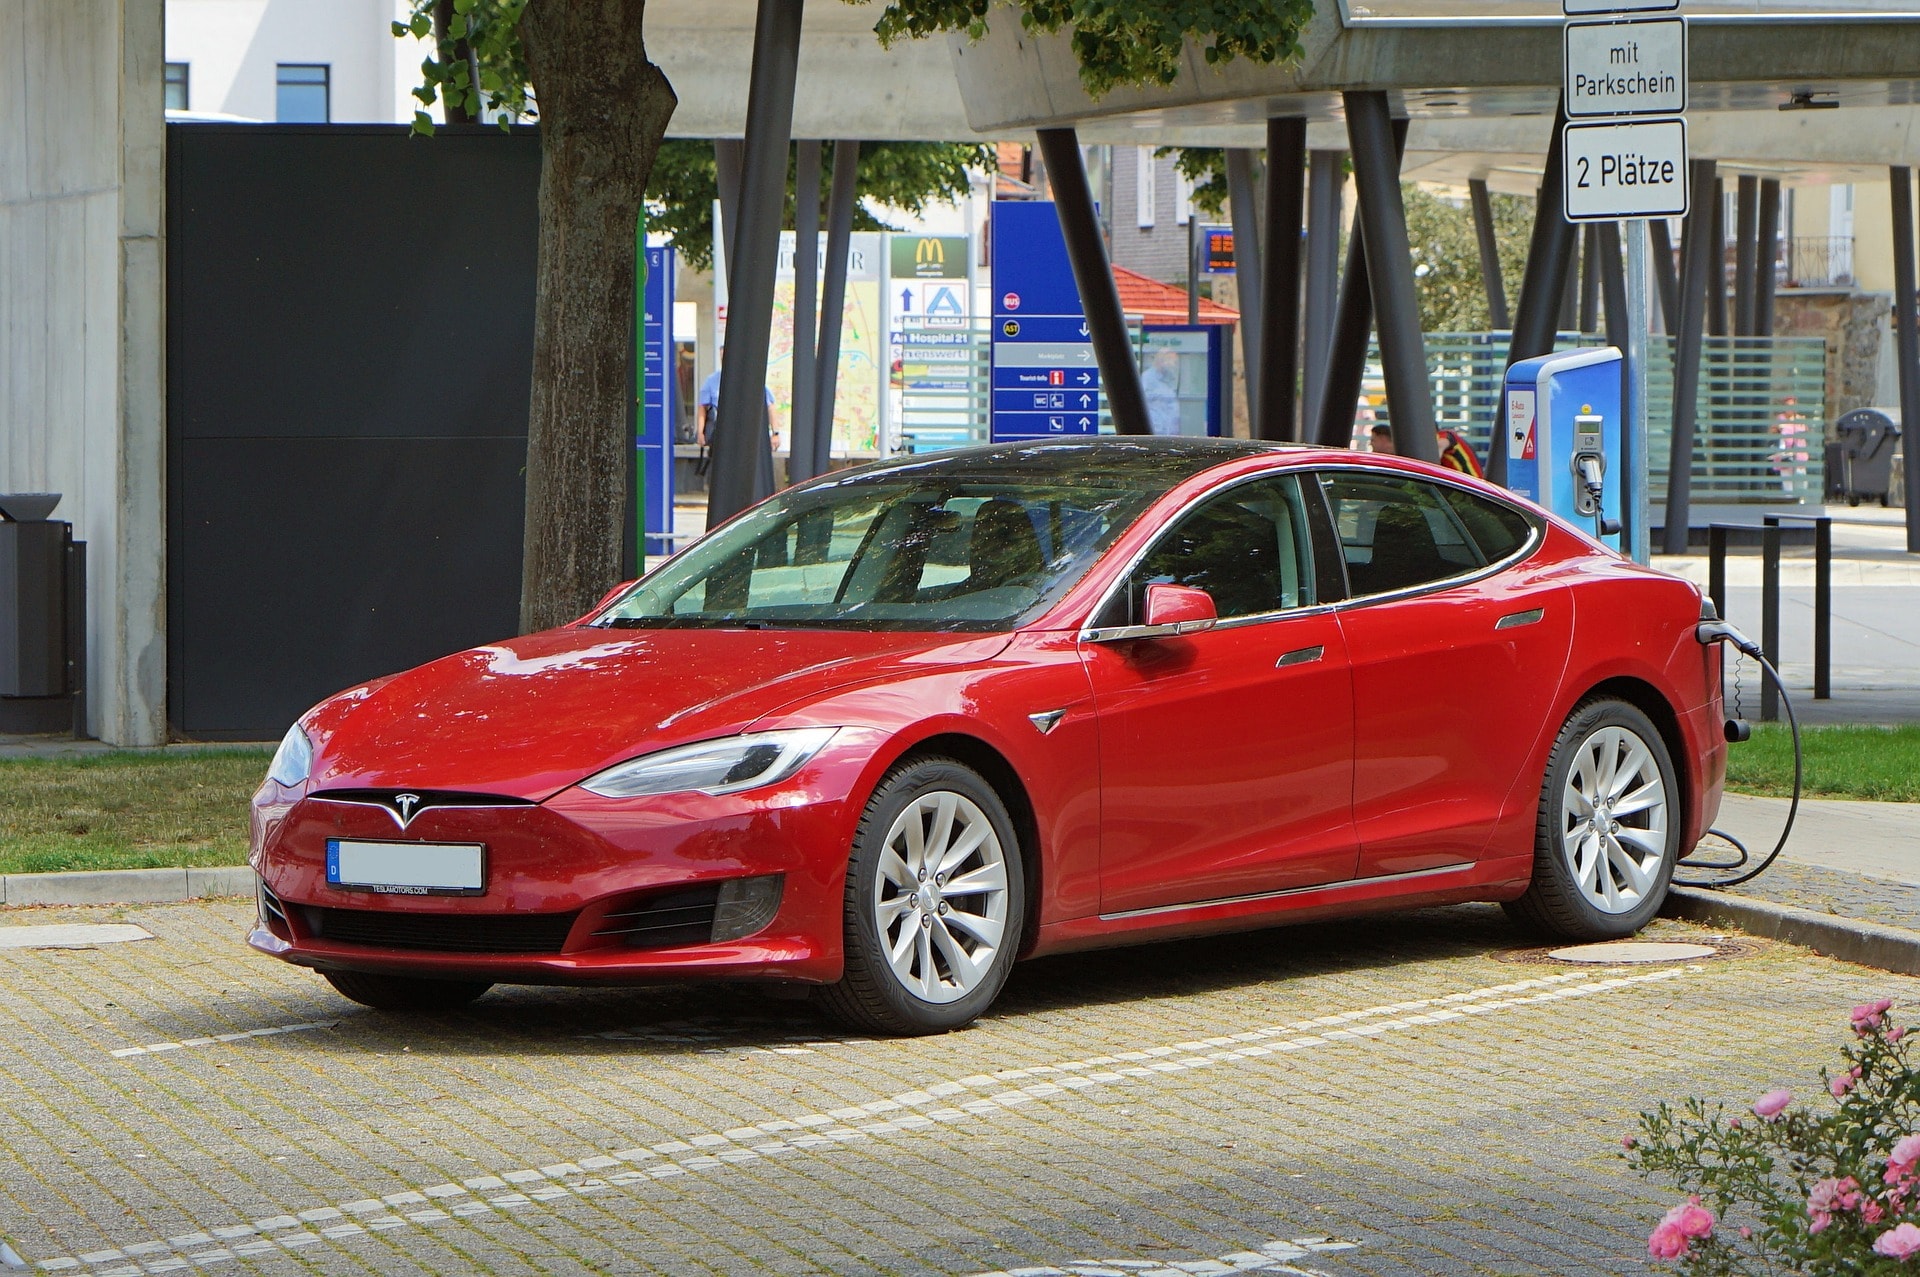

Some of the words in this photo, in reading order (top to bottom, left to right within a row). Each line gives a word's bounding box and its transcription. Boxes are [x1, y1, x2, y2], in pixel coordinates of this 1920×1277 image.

[1610, 41, 1639, 64] mit
[1576, 70, 1675, 96] Parkschein
[1576, 156, 1590, 188] 2
[1601, 153, 1675, 187] Plätze
[1003, 297, 1019, 306] BUS
[1004, 324, 1018, 333] AST
[331, 865, 337, 875] D
[372, 885, 428, 895] TESLAMOTORS.COM
